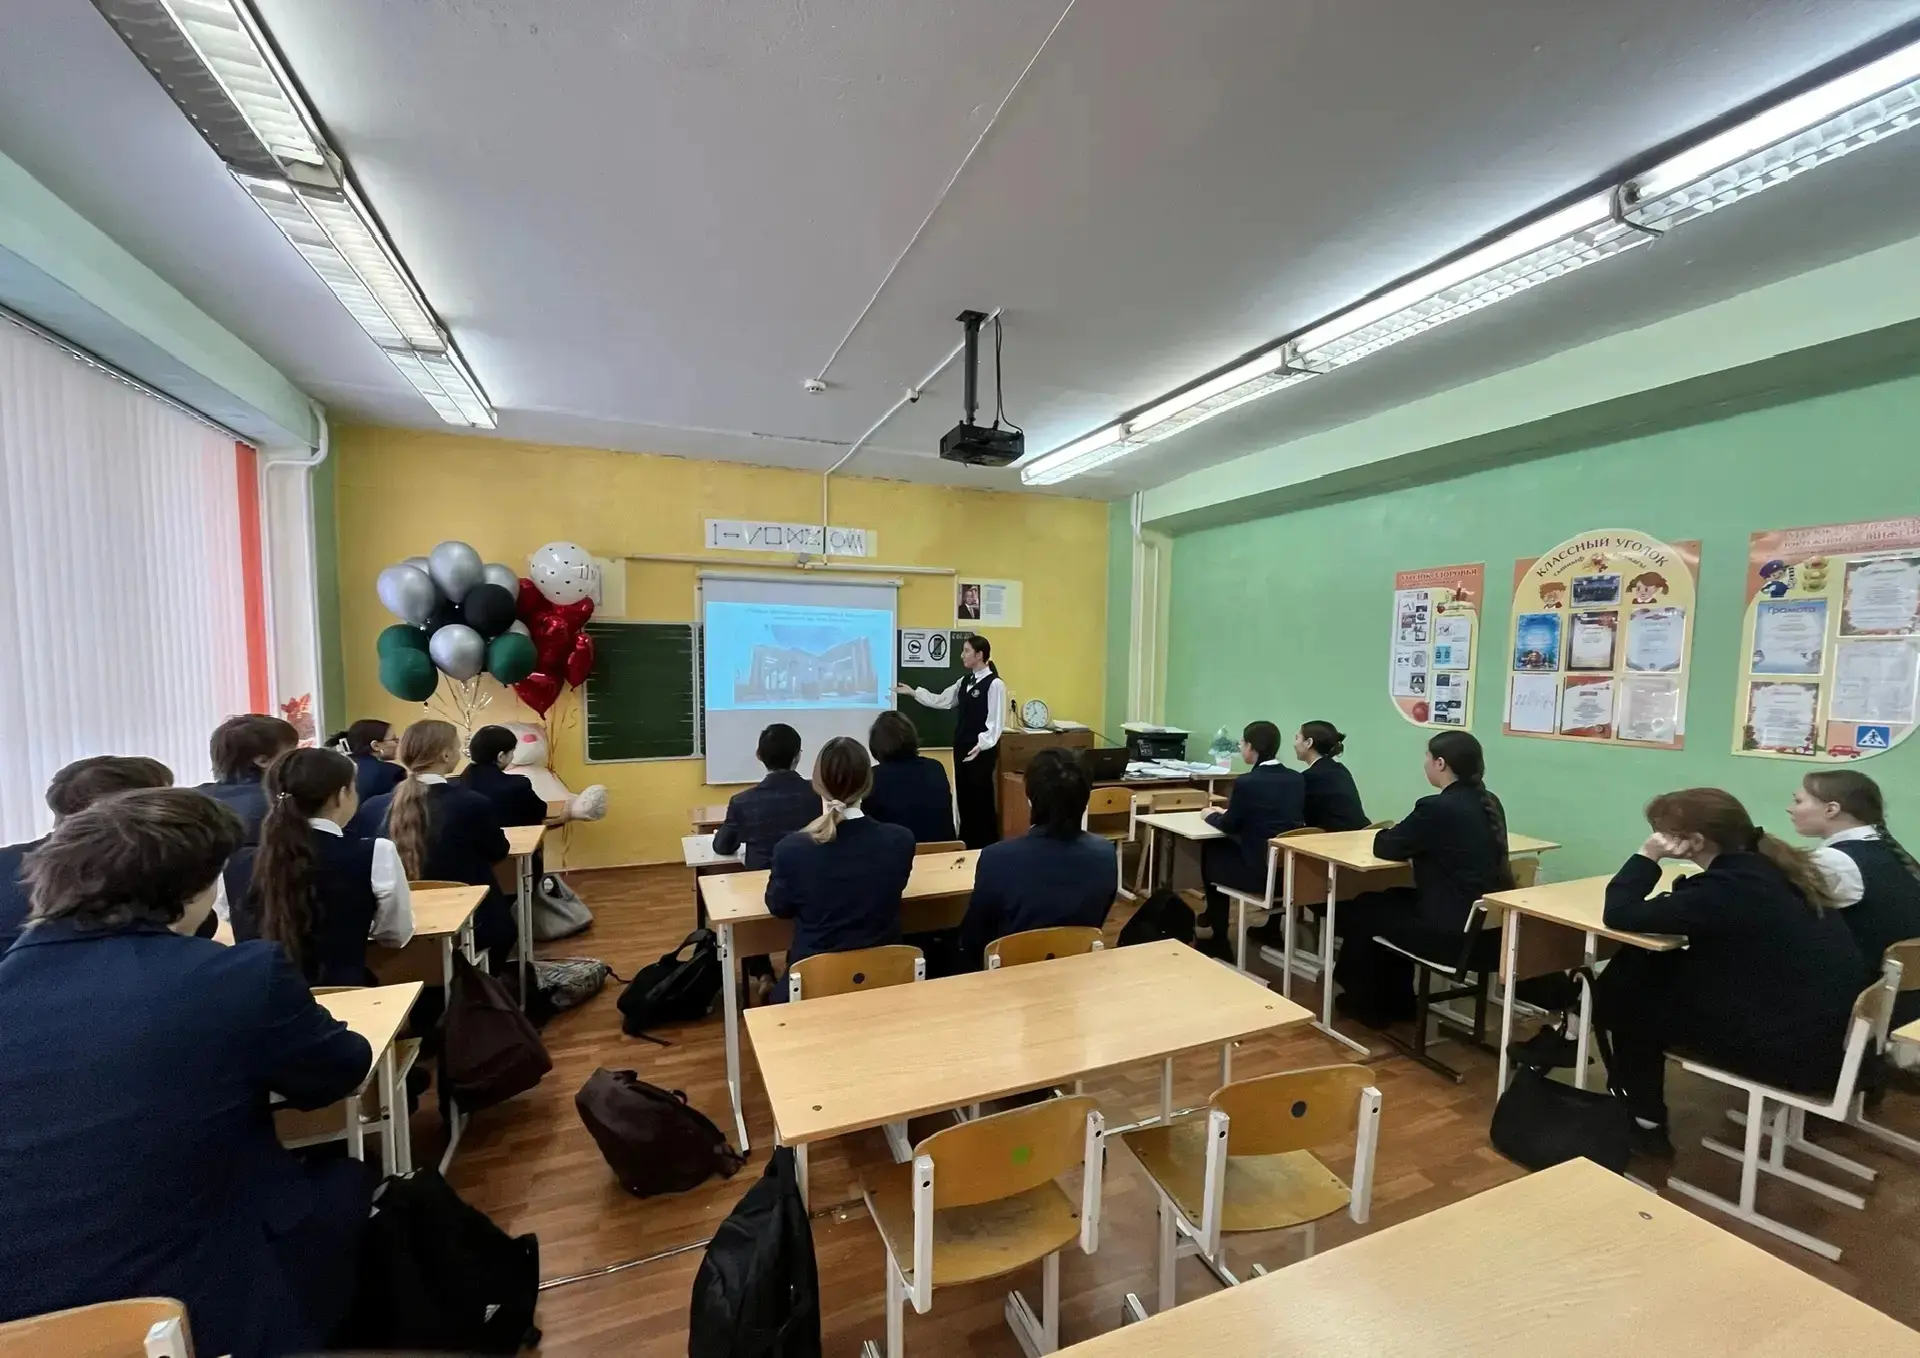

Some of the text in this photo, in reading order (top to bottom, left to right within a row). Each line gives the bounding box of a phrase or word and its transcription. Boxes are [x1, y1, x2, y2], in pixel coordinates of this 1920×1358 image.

[1536, 537, 1669, 578] КЛАССНЫЙ УГОЛОК
[1767, 606, 1817, 615] Грамота
